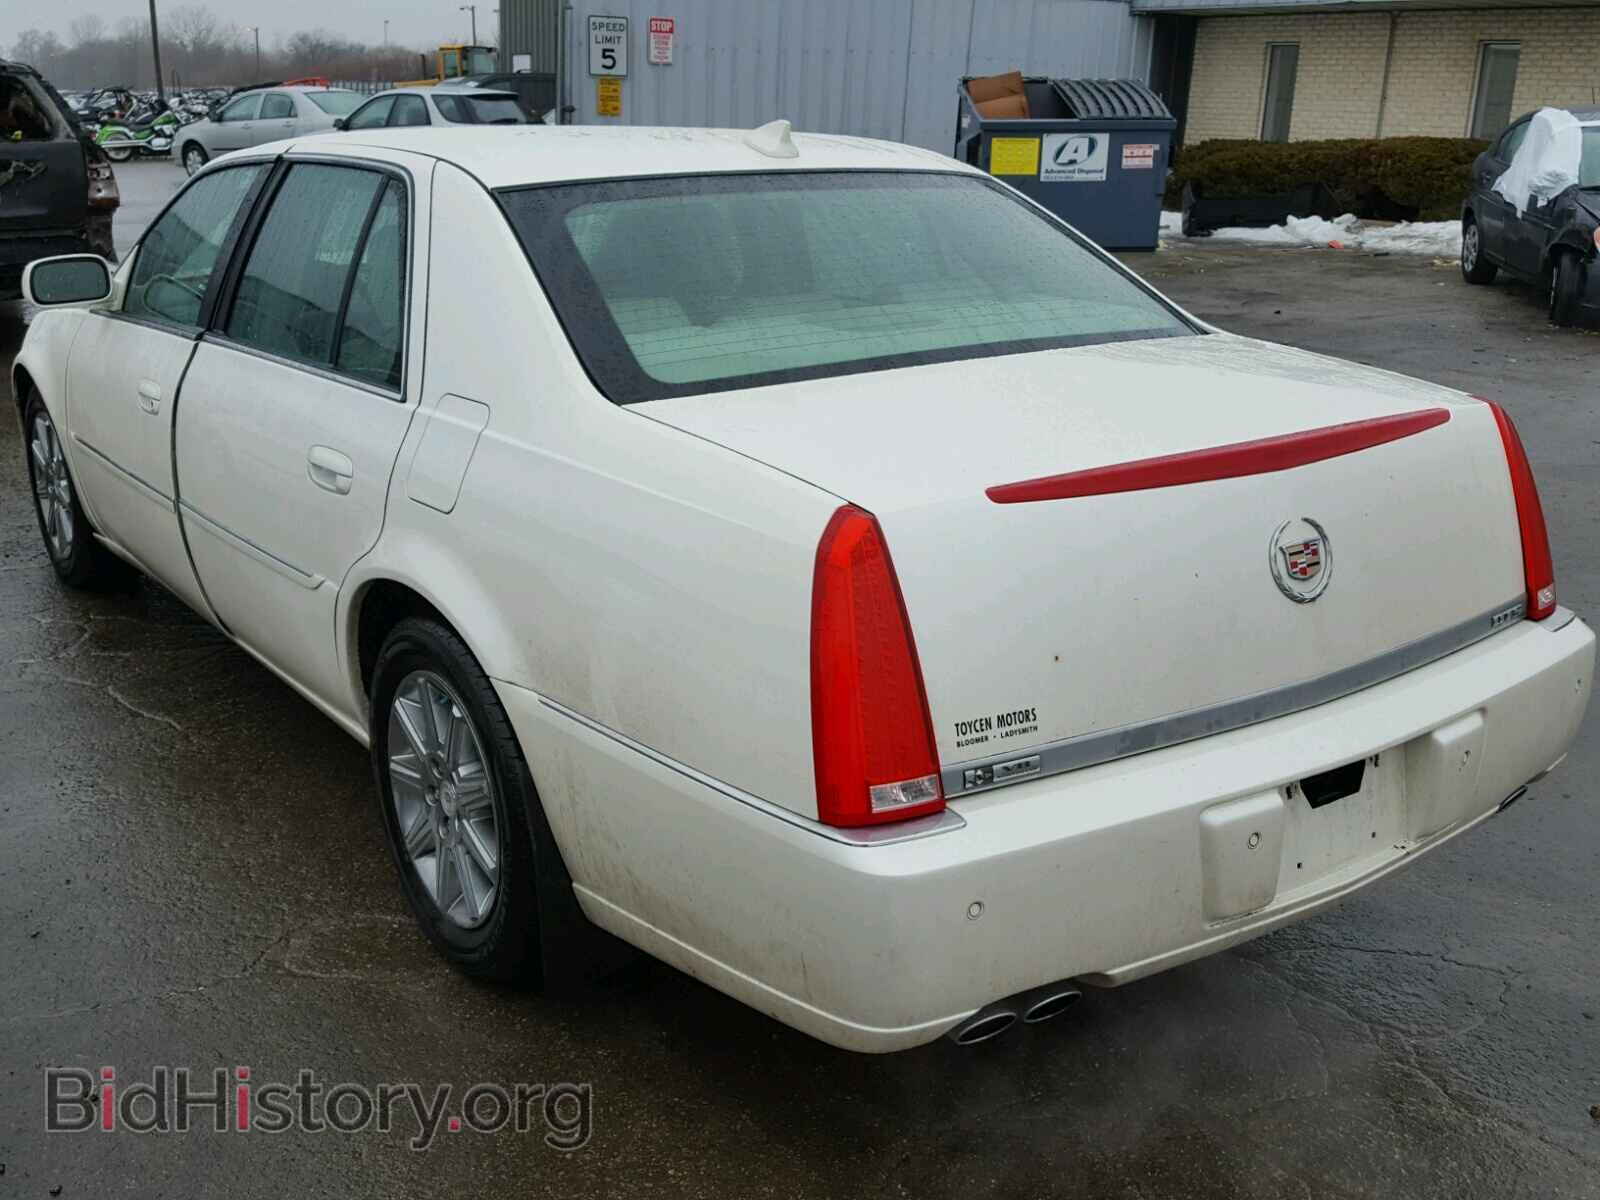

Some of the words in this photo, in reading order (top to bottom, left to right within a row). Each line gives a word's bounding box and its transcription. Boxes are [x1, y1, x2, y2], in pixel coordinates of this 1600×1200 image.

[592, 22, 625, 32] SPEED
[651, 20, 672, 32] STOP
[595, 35, 622, 45] LIMIT
[601, 49, 617, 69] 5
[954, 717, 992, 737] TOYCEN
[996, 707, 1037, 729] MOTORS
[956, 735, 989, 748] BLOOMER
[1000, 725, 1038, 739] LADYSMITH
